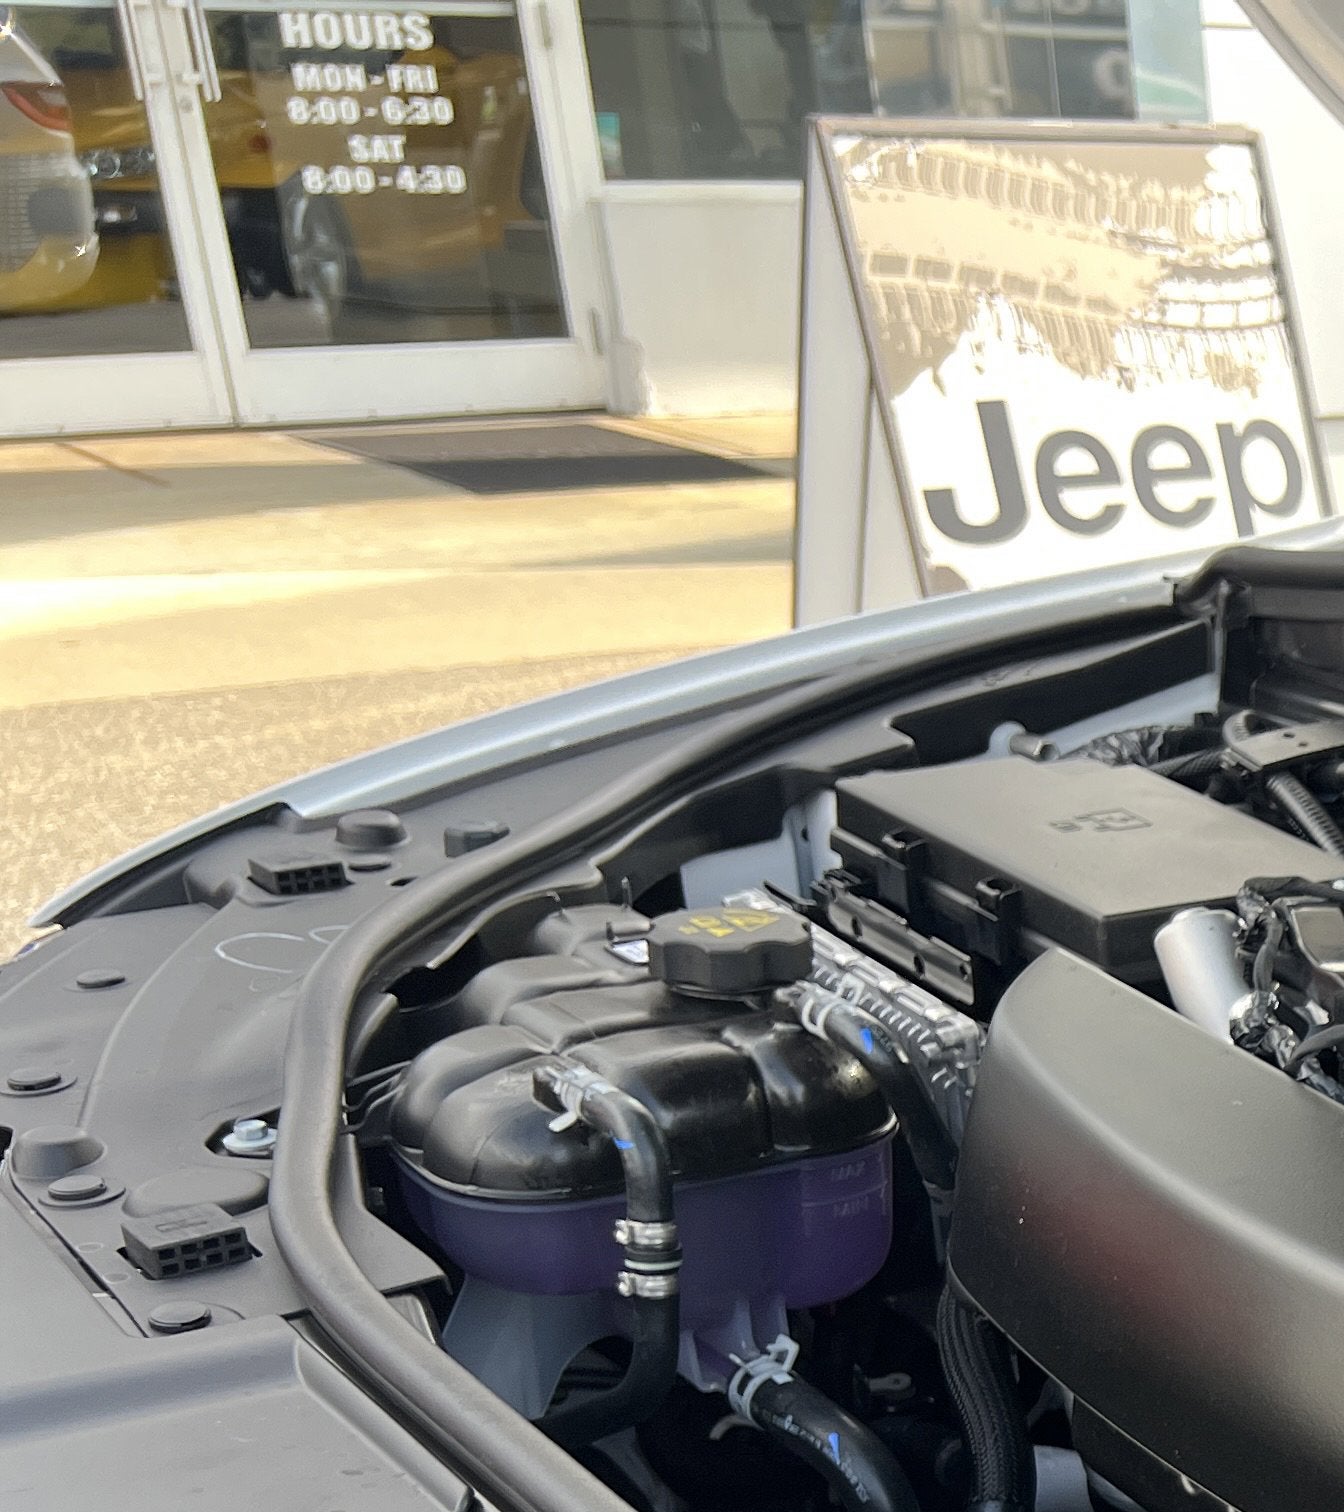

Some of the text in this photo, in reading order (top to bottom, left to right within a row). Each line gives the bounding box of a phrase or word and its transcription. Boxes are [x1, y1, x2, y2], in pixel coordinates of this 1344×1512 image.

[278, 11, 435, 50] HOURS
[347, 133, 407, 164] SAT
[921, 399, 1302, 544] Jeep
